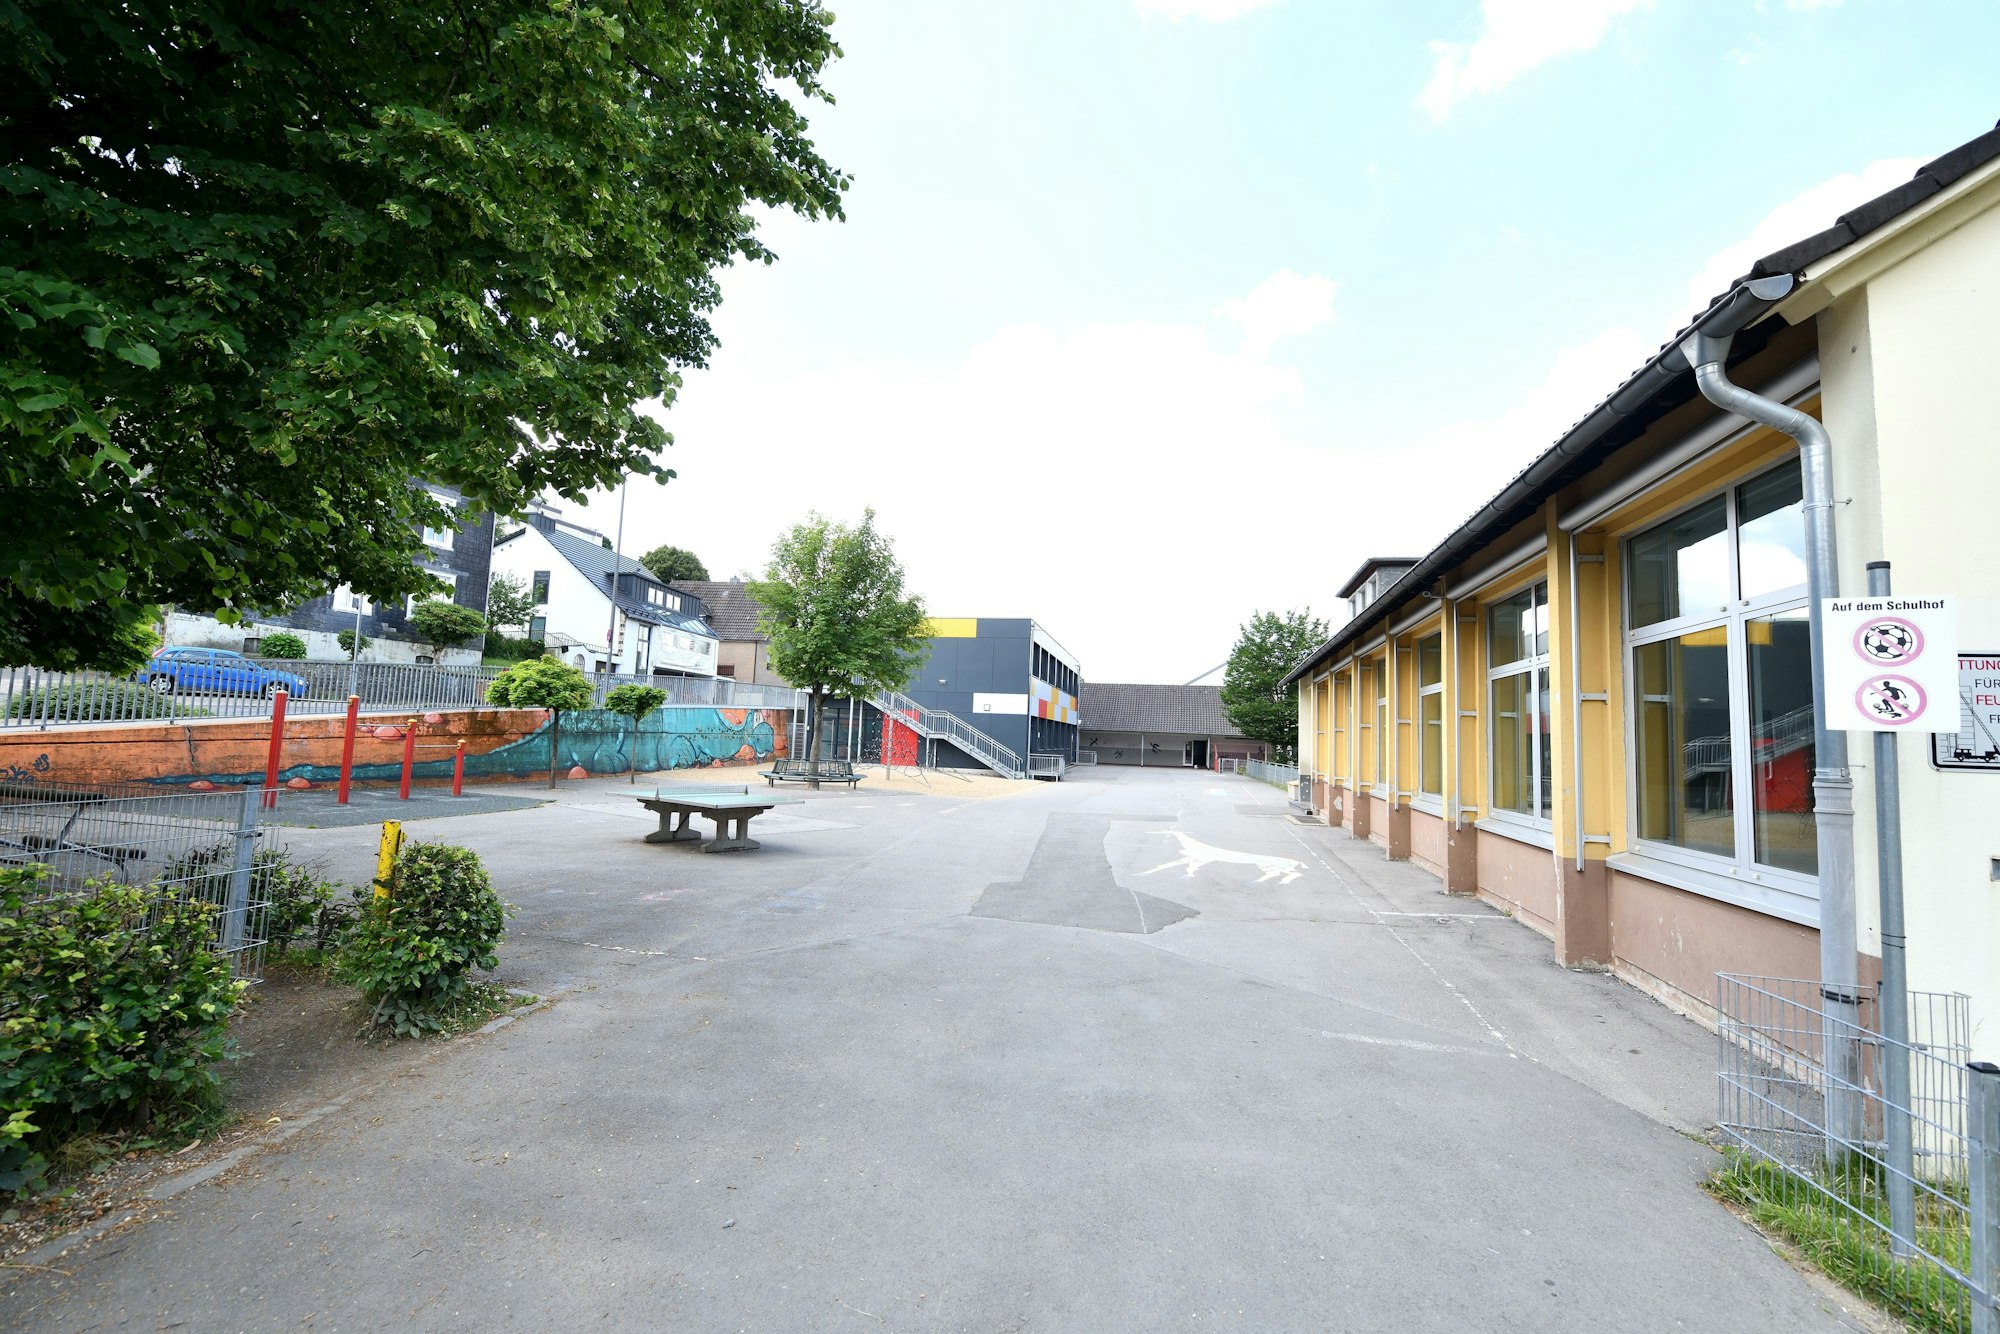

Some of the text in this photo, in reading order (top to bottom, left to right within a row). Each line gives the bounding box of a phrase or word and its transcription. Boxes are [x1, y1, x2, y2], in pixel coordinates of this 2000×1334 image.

[1831, 599, 1945, 612] Auf dem Schulhof
[1989, 714, 2000, 724] F
